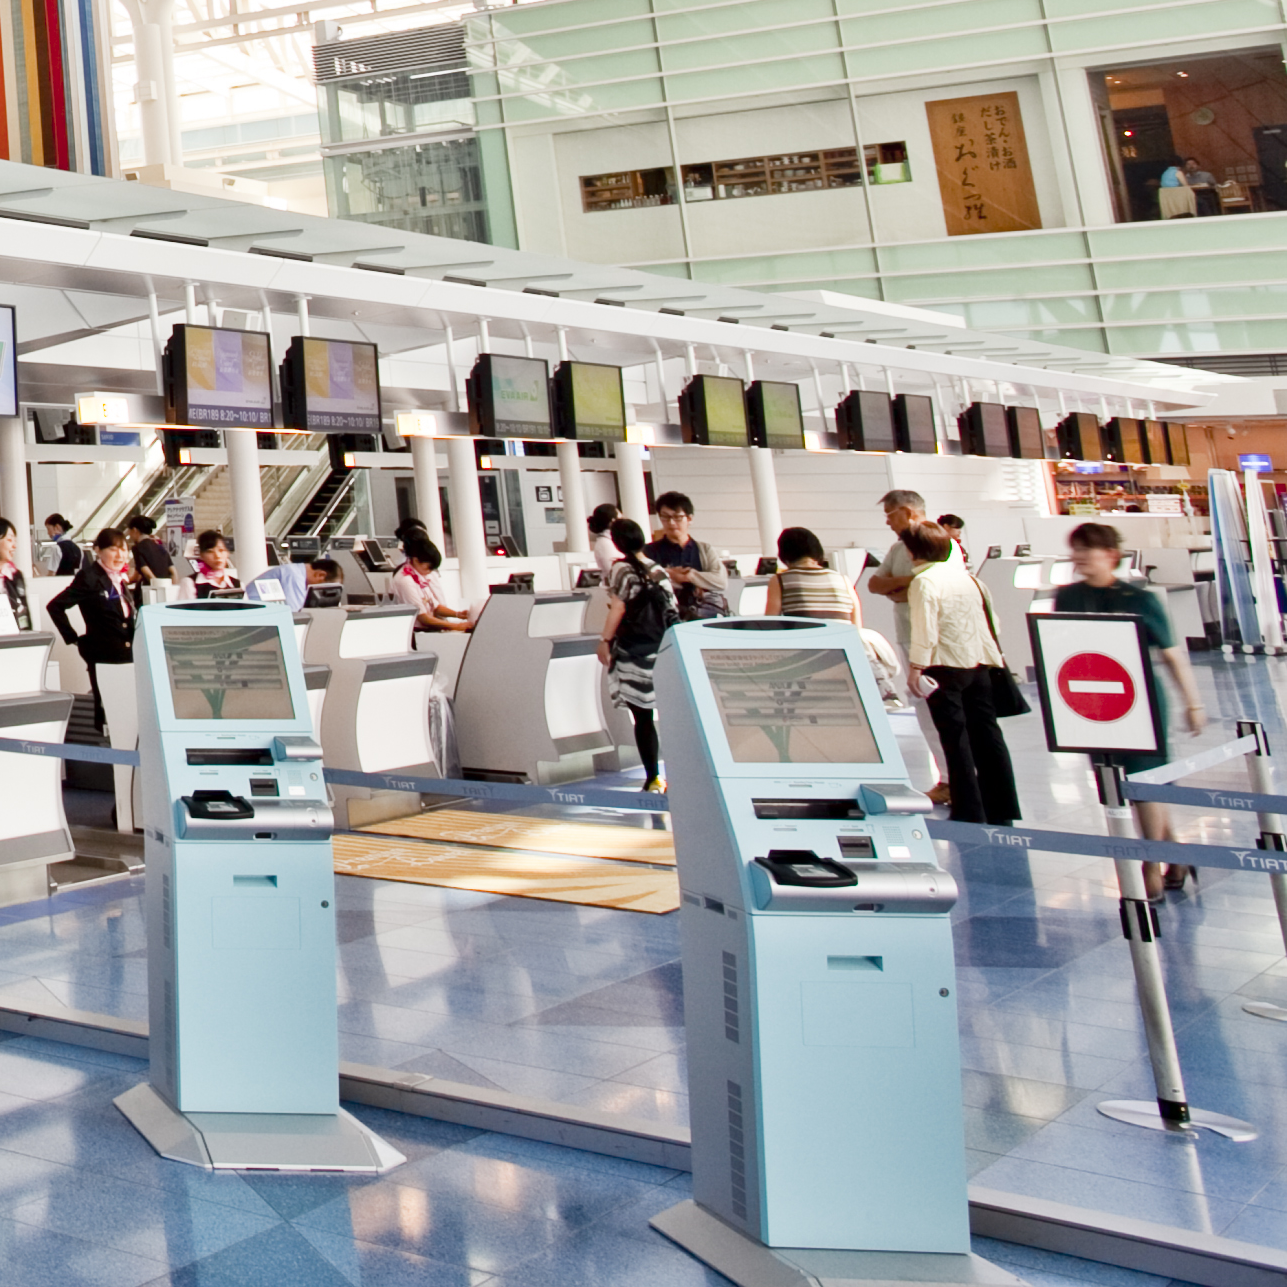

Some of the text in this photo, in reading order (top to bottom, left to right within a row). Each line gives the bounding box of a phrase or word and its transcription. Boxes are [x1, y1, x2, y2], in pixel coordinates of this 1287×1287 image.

[26, 745, 46, 754] TIAT
[390, 779, 416, 790] TIAT
[557, 792, 586, 804] TIAT
[1217, 796, 1255, 809] TIAT
[994, 832, 1033, 847] TIAT
[1246, 856, 1287, 871] TIAT
